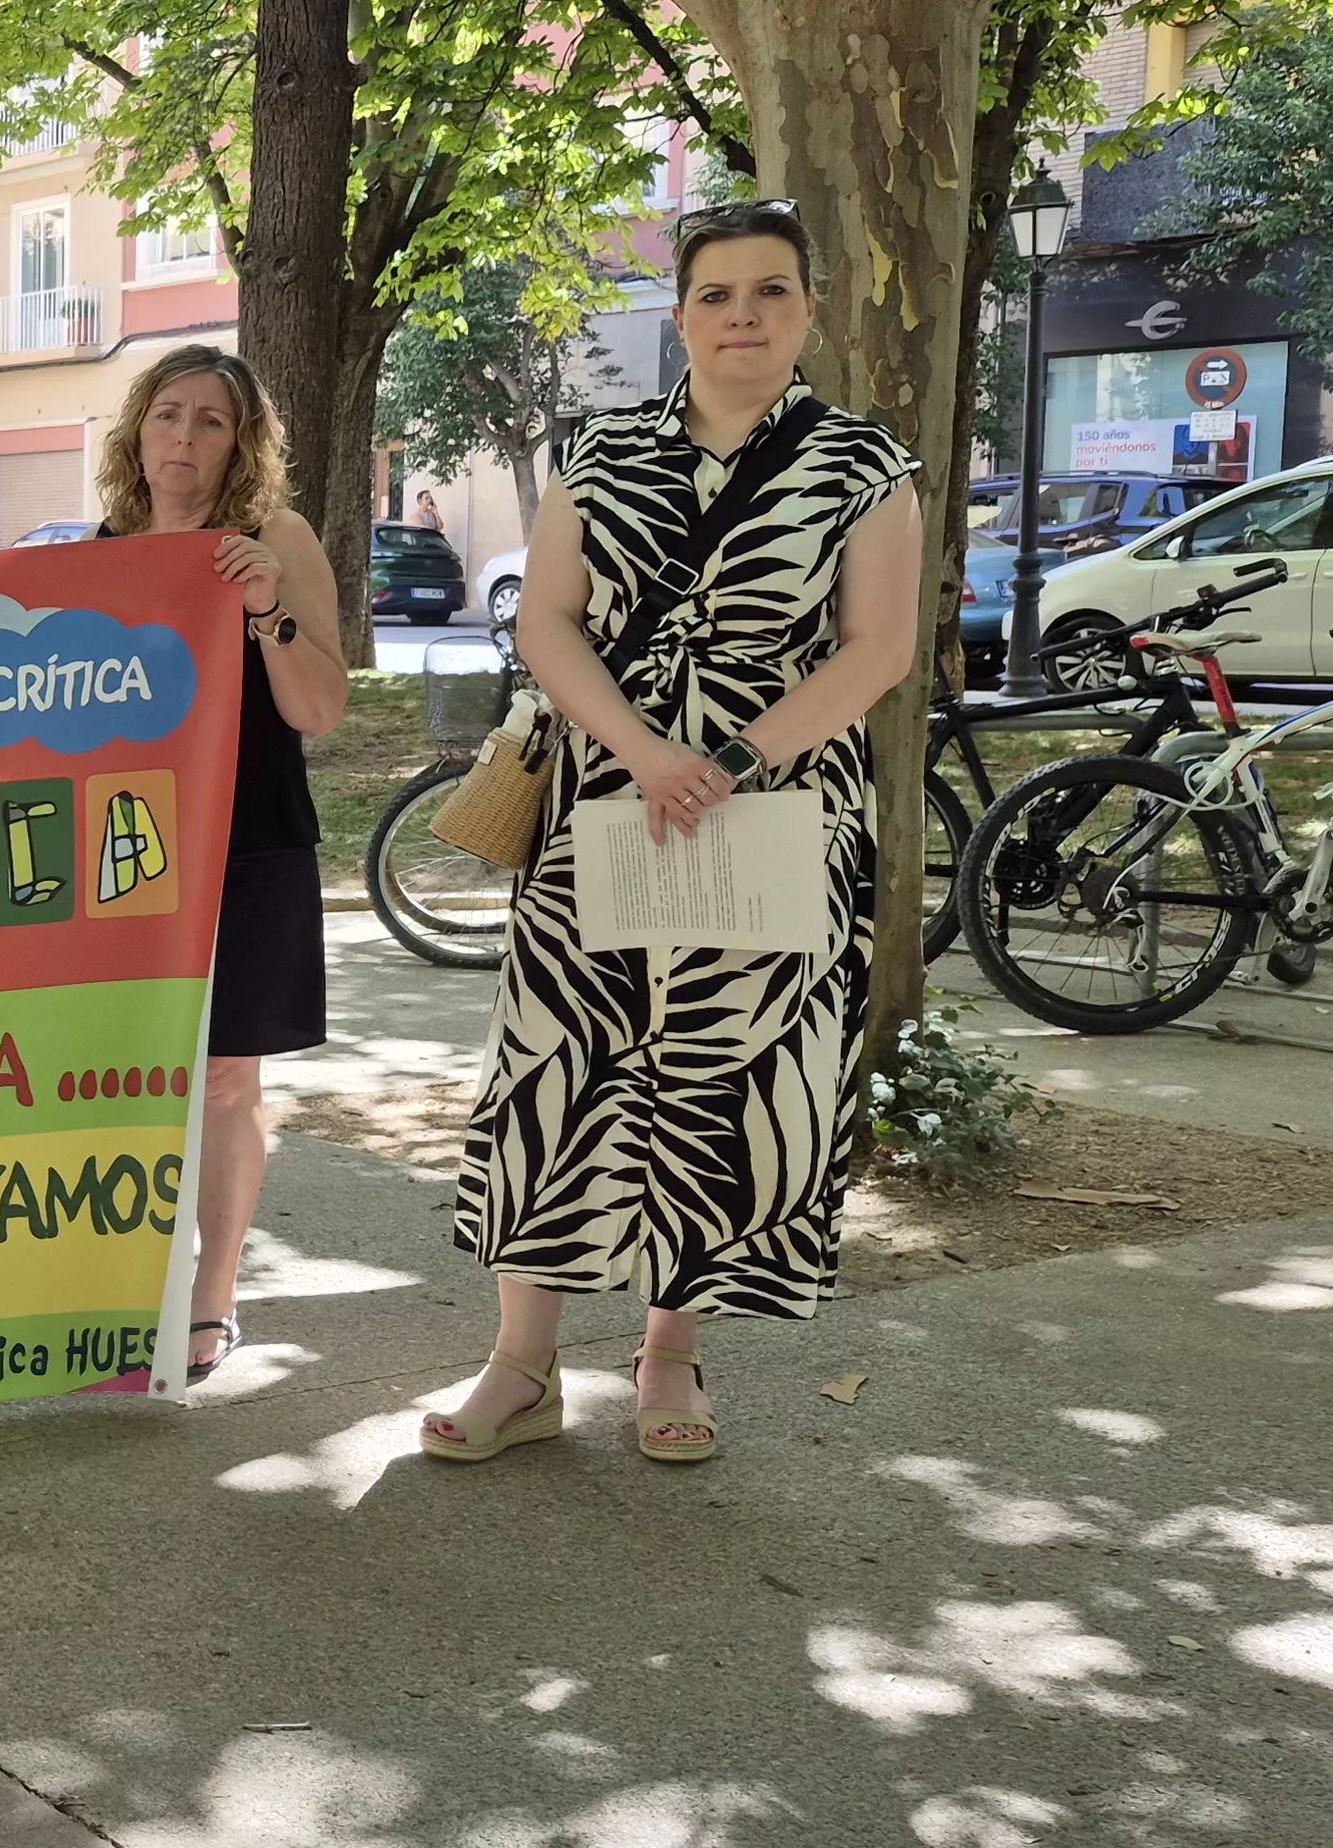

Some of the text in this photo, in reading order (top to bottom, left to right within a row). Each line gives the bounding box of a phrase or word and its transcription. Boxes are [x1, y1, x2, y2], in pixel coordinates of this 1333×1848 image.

[1078, 428, 1130, 441] 150 años
[1076, 442, 1156, 454] moviéndonos
[1076, 455, 1108, 469] por ti
